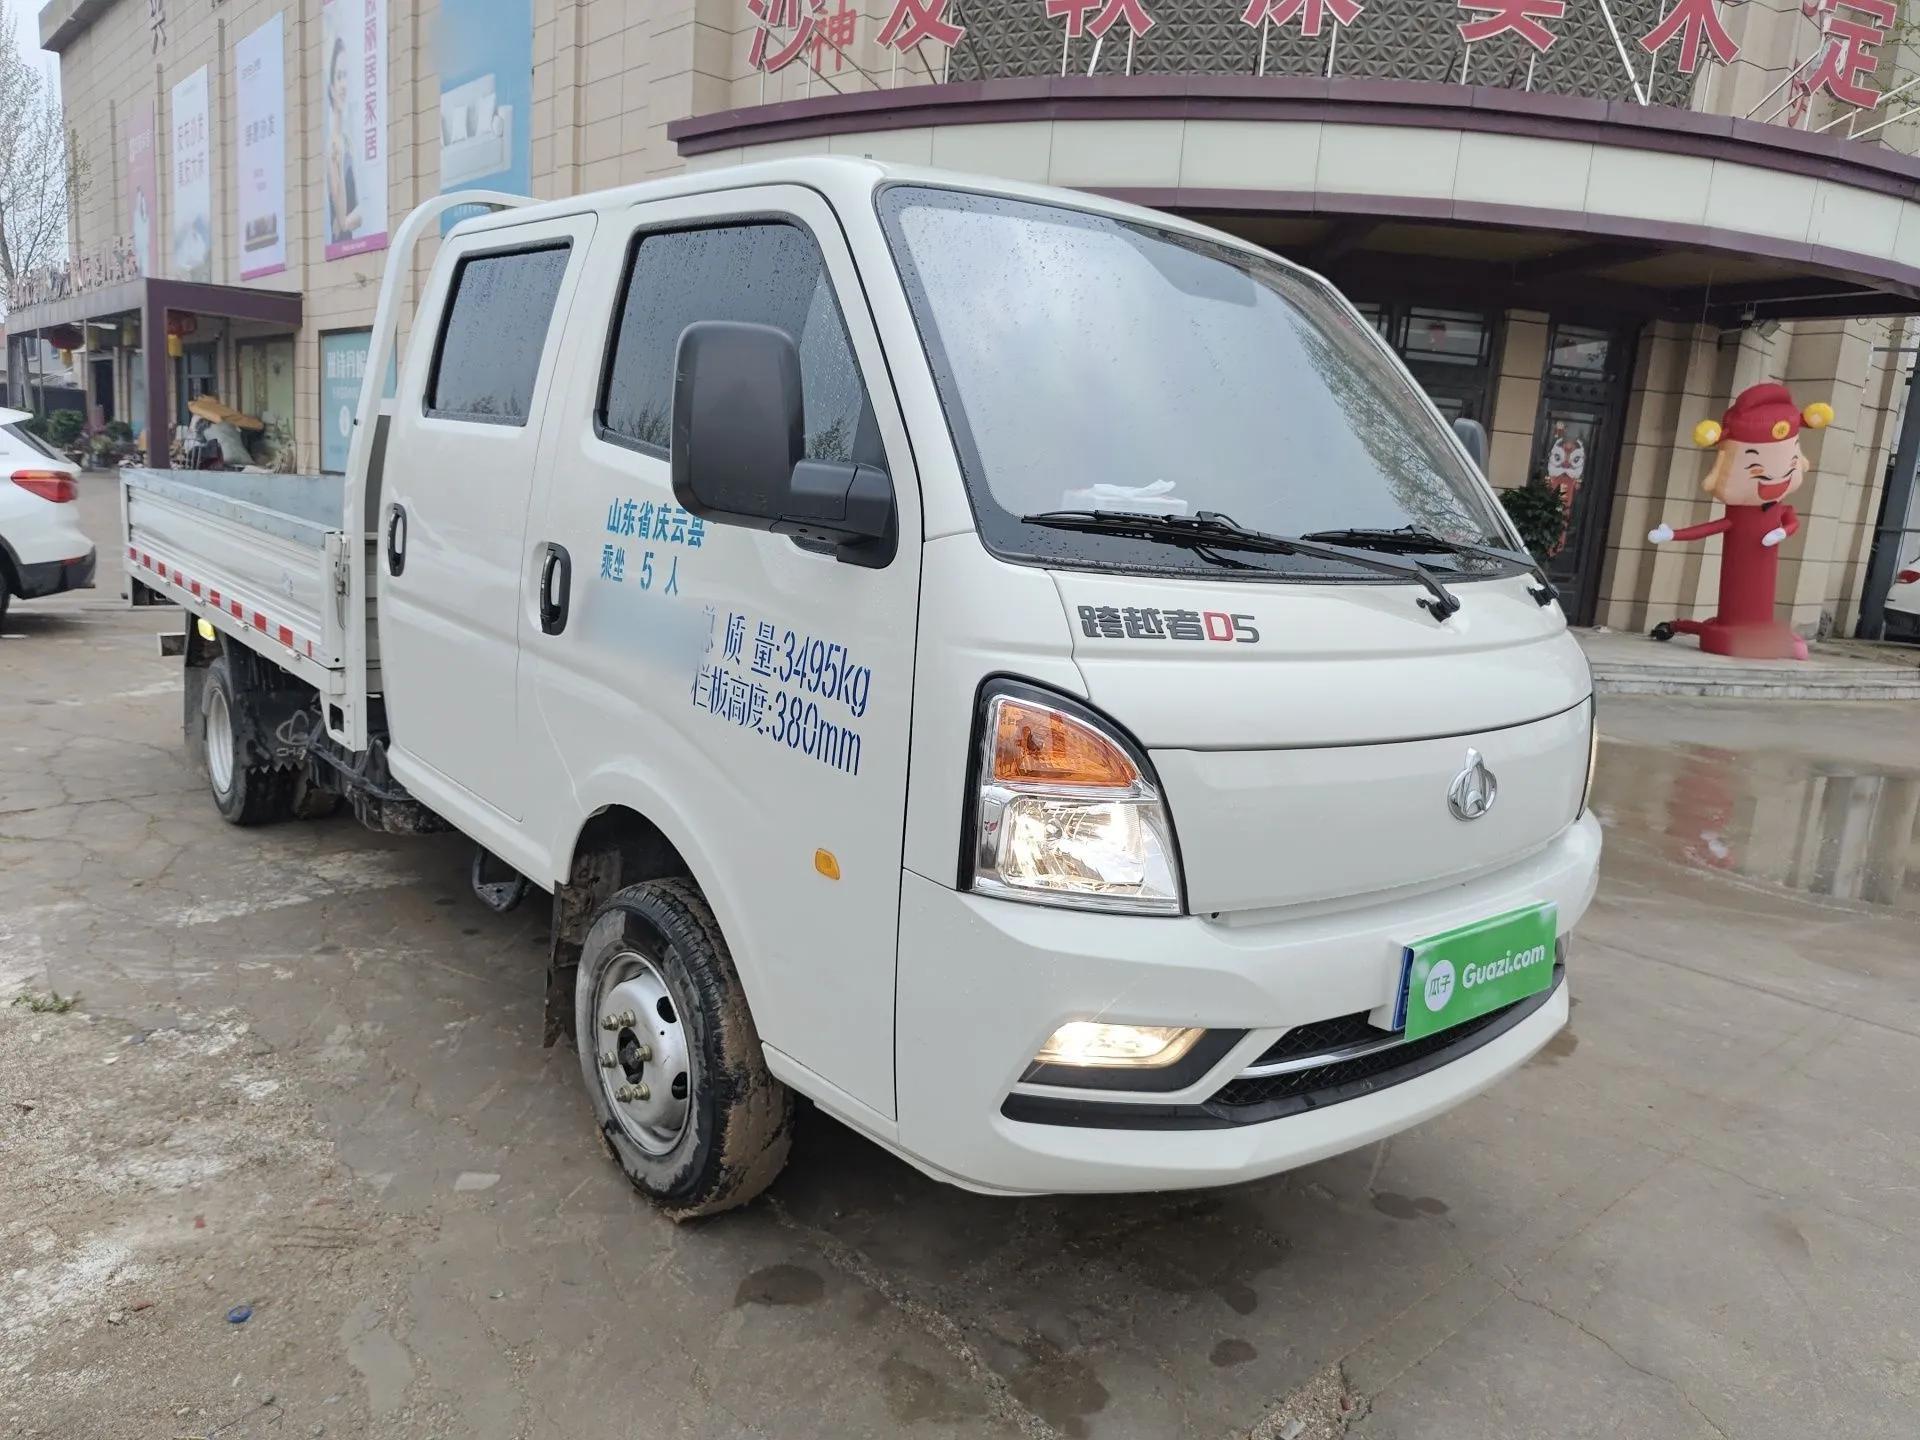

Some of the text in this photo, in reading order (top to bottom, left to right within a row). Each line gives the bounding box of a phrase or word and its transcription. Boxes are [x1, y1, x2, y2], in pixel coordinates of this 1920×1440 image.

[607, 498, 705, 549] 山东省庆云县
[601, 544, 678, 596] 乘坐 5 人
[1078, 606, 1260, 643] 跨越者D5
